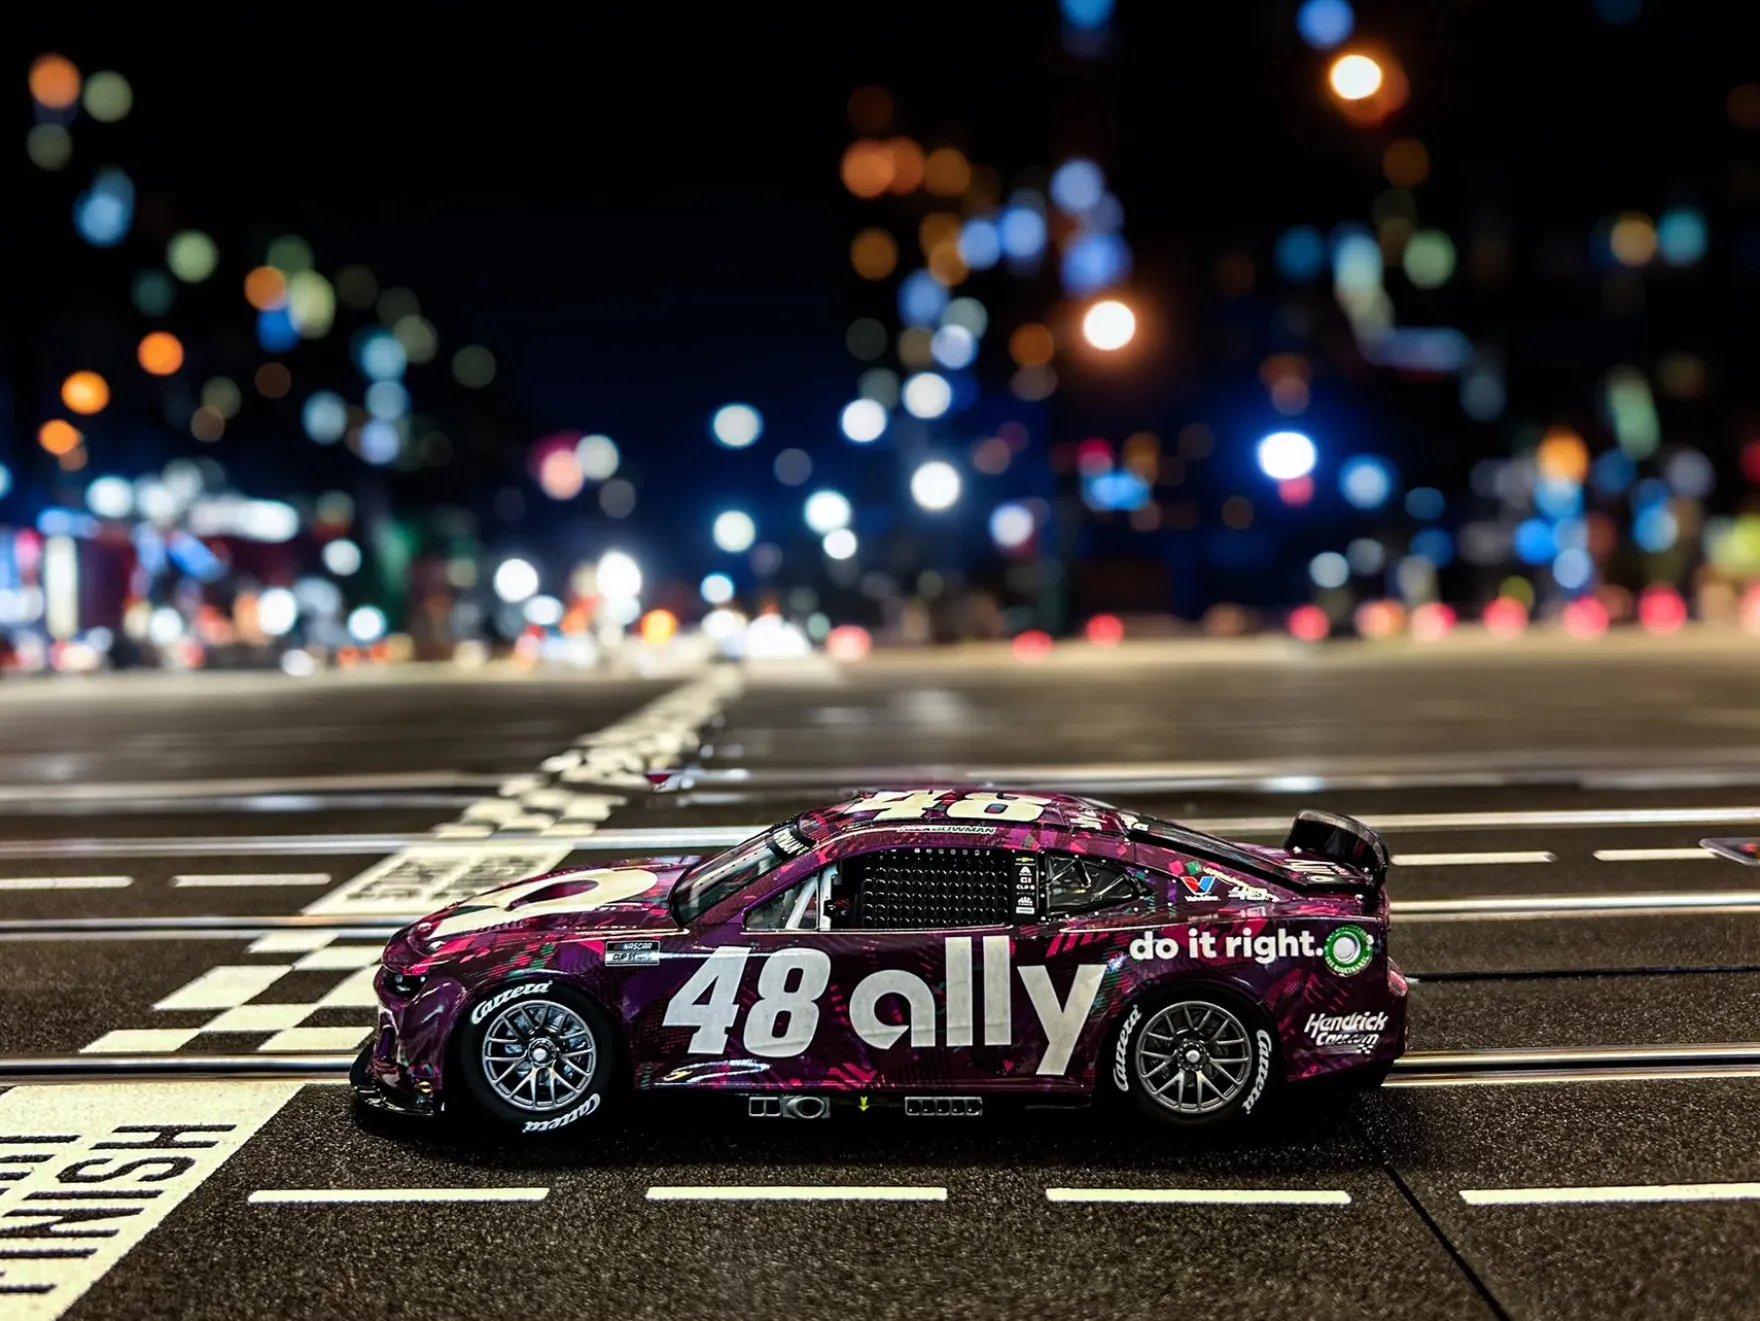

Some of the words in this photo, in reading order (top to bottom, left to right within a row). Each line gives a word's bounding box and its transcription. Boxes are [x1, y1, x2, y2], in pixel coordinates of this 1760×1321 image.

[1129, 931, 1179, 960] do
[1188, 927, 1216, 959] it
[1226, 927, 1324, 964] right.
[471, 980, 553, 1024] Carrera
[662, 945, 832, 1058] 48
[849, 935, 1107, 1075] ally
[1303, 1011, 1389, 1038] Hendrick
[1113, 1004, 1142, 1092] Carrera
[1242, 1029, 1272, 1114] Carrera
[522, 1093, 601, 1133] Carrera
